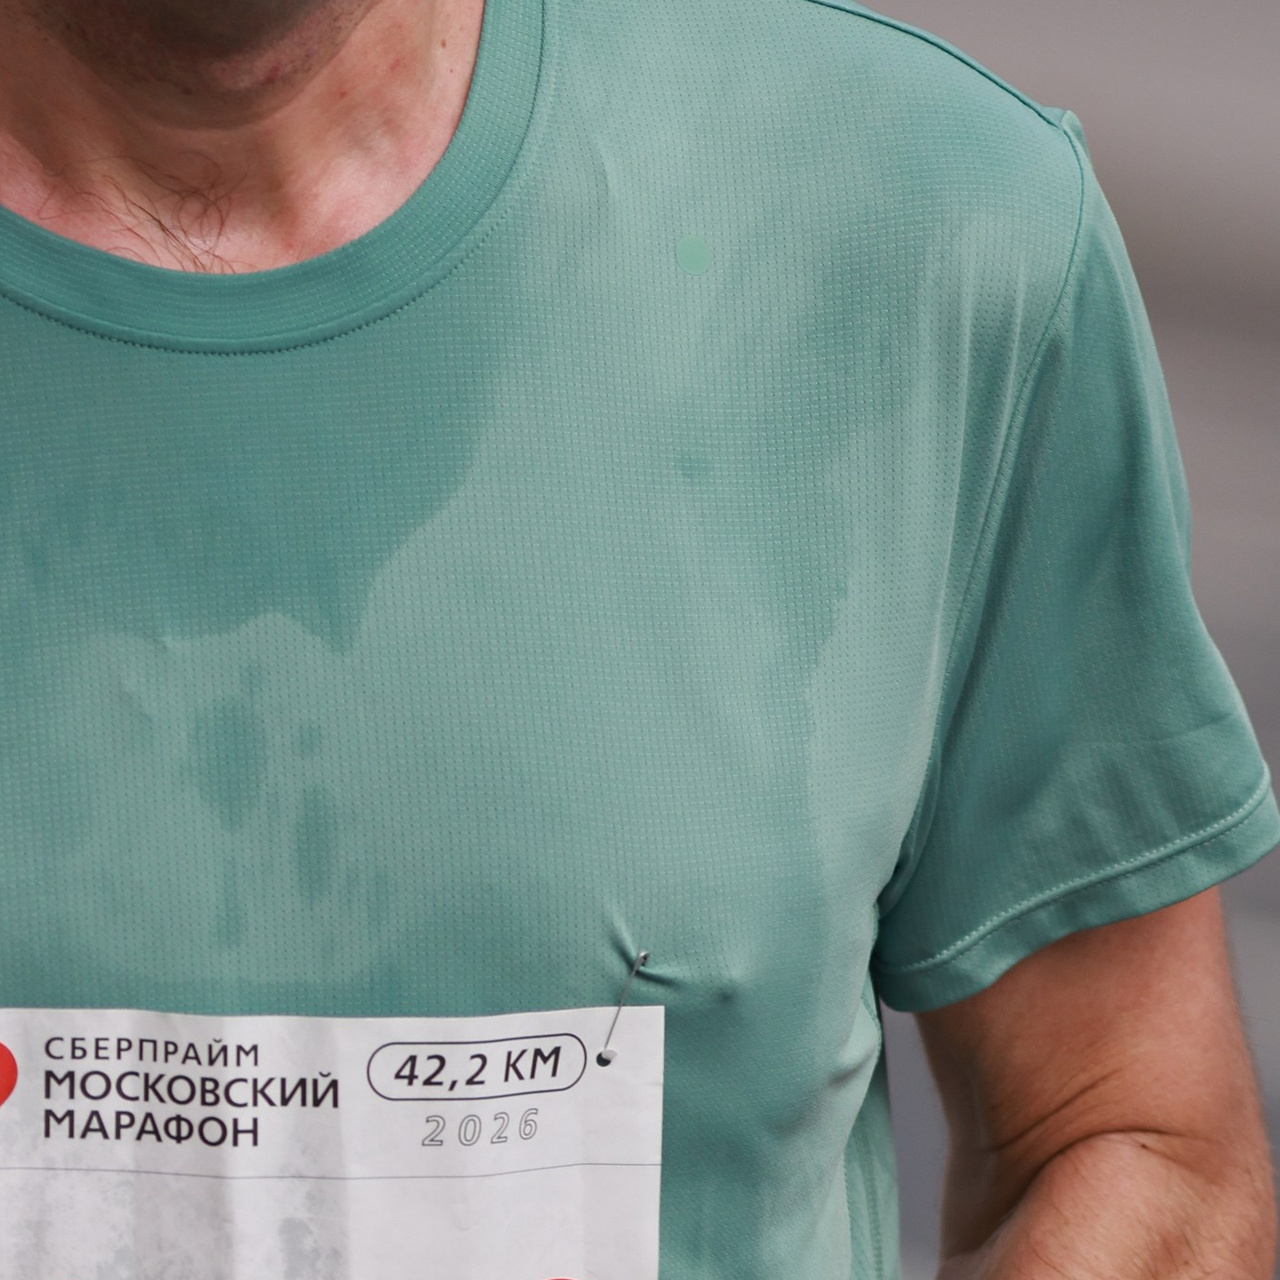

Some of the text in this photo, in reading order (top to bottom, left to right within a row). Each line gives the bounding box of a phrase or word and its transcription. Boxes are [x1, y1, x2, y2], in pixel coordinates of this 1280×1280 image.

[43, 1035, 261, 1068] СБЕРПРАЙМ
[393, 1045, 564, 1094] 42,2 КМ
[43, 1069, 341, 1109] МОСКОВСКИЙ
[43, 1109, 261, 1148] МАРАФОН
[421, 1107, 541, 1148] 2026
